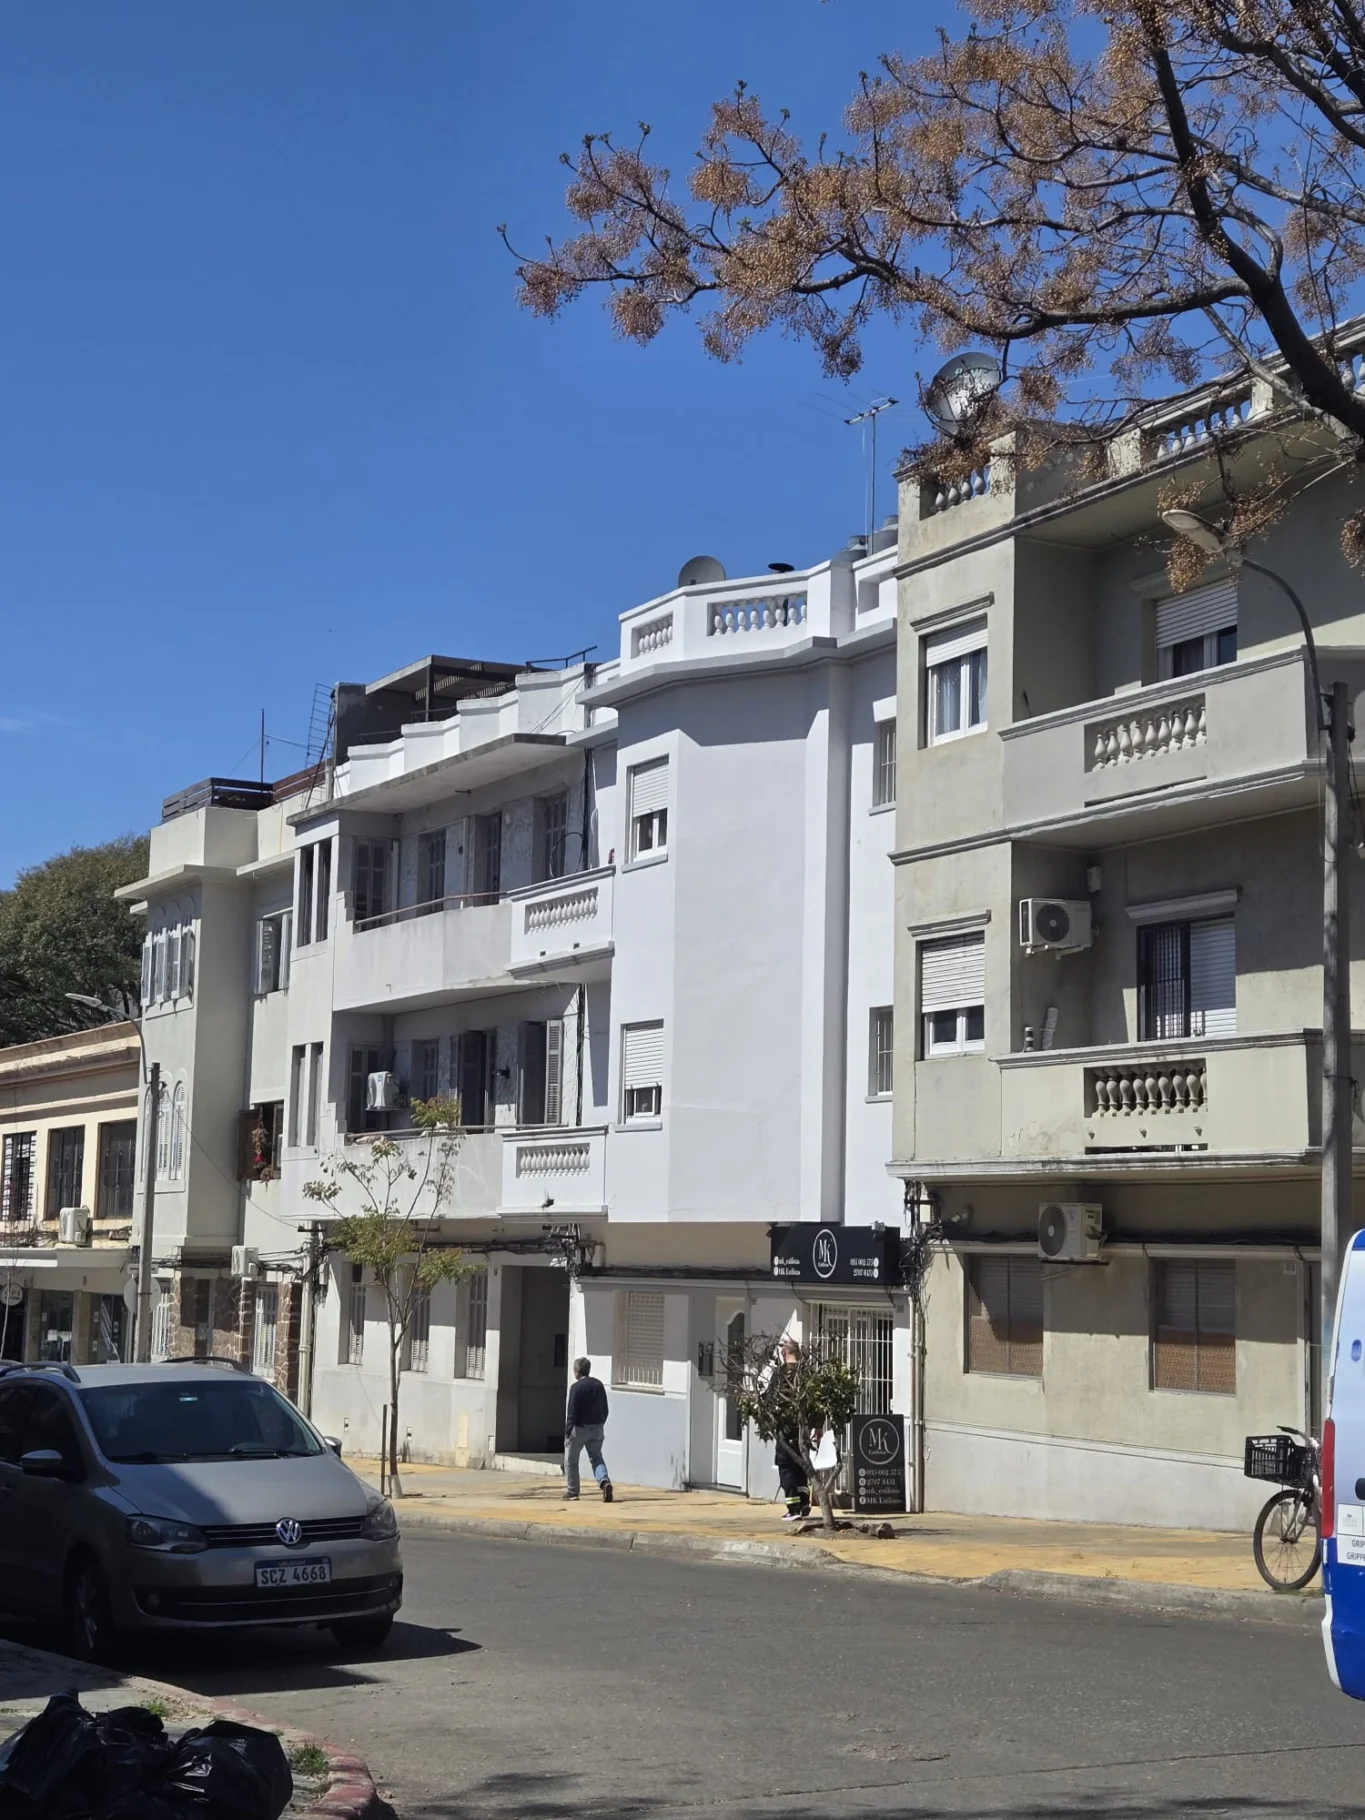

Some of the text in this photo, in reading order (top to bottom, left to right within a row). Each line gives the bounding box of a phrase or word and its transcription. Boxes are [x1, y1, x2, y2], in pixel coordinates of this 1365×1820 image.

[869, 1428, 893, 1454] MK
[261, 1566, 326, 1584] SCZ 4668
